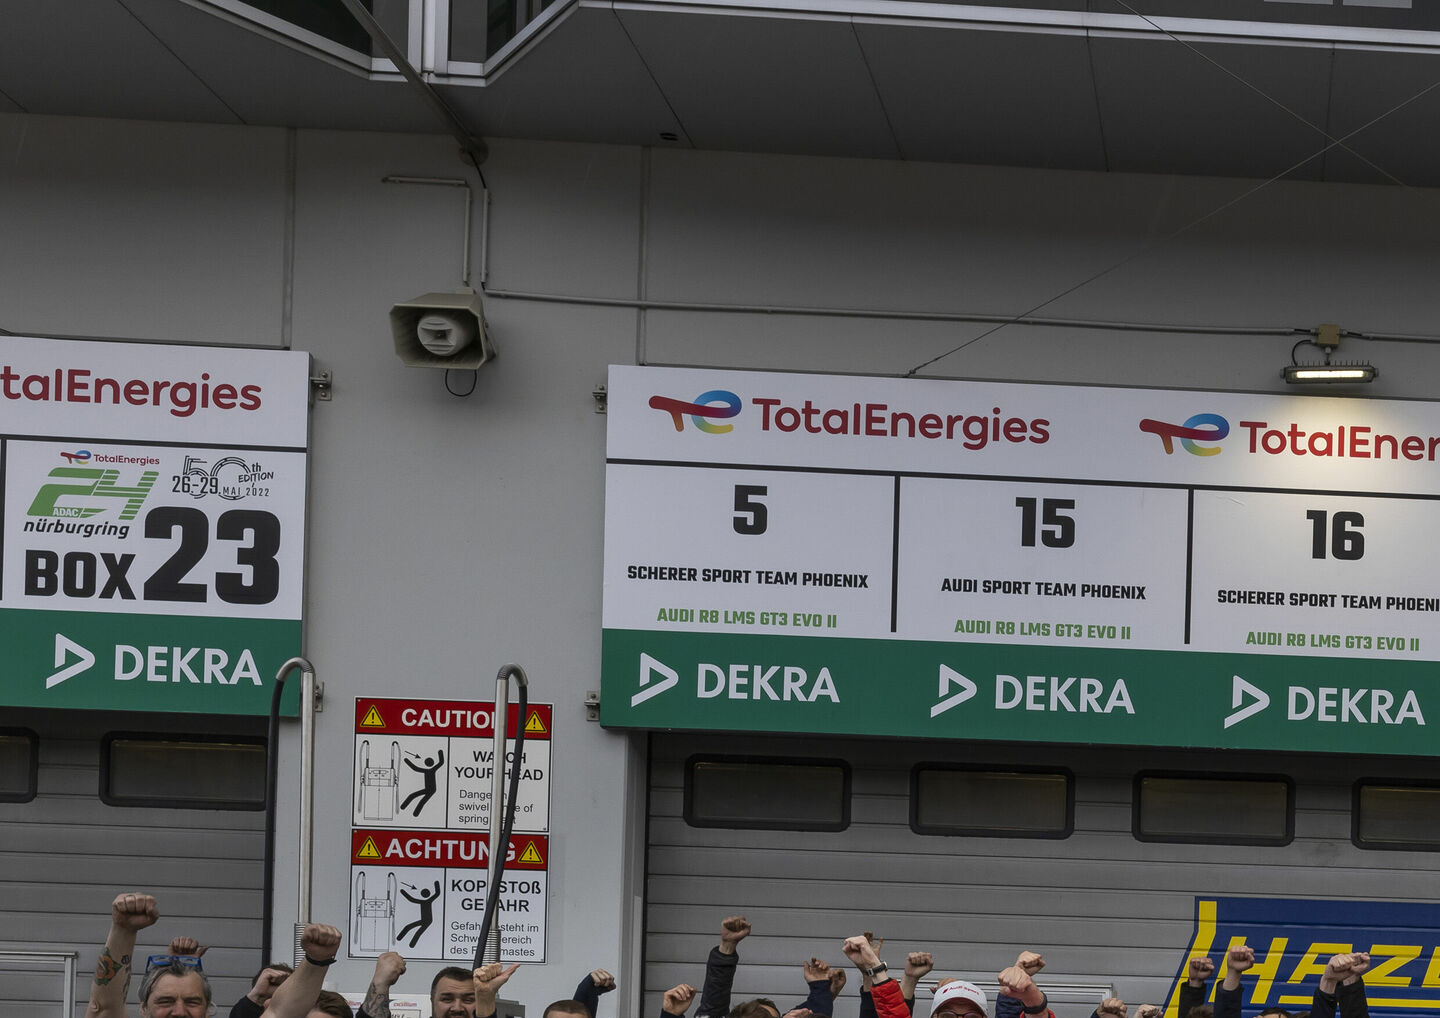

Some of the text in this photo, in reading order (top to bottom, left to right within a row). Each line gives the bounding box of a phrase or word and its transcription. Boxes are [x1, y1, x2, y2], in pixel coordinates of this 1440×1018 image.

[752, 397, 1050, 450] TotalEnergies
[93, 453, 160, 466] TotalEnergies
[238, 471, 275, 484] EDITION
[222, 486, 241, 496] MAI
[246, 486, 270, 497] 2022
[52, 507, 79, 518] ADAC
[733, 484, 768, 535] 5
[23, 518, 130, 539] nürburgring
[1015, 496, 1076, 548] 15
[1306, 509, 1365, 561] 16
[25, 506, 281, 605] BOX 23
[627, 565, 869, 588] SCHERER SPORT TEAM PHOENIX
[941, 578, 1146, 600] AUDI SPORT TEAM PHOENIX
[1217, 590, 1285, 606] SCHERER
[1289, 592, 1337, 608] SPORT
[1341, 594, 1382, 610] TEAM
[657, 608, 837, 628] AUDI R8 LMS GT3 EVO II
[954, 619, 1131, 640] AUDI R8 LMS GT3 EVO II
[1246, 631, 1420, 652] AUDI R8 LMS GT3 EVO II
[114, 644, 263, 686] DEKRA
[697, 662, 840, 703] DEKRA
[995, 674, 1136, 714] DEKRA
[1288, 686, 1426, 726] DEKRA
[401, 708, 496, 730] CAUTIO
[473, 750, 527, 764] WACH
[504, 768, 544, 781] HAD
[459, 789, 493, 801] Dange
[458, 803, 489, 812] swivel
[523, 804, 534, 813] of
[458, 814, 489, 825] spring
[385, 838, 516, 862] ACHTUNG
[451, 879, 542, 895] KOPSTOß
[461, 897, 530, 913] GEAHR
[450, 920, 539, 932] Gefah im
[450, 945, 468, 955] des
